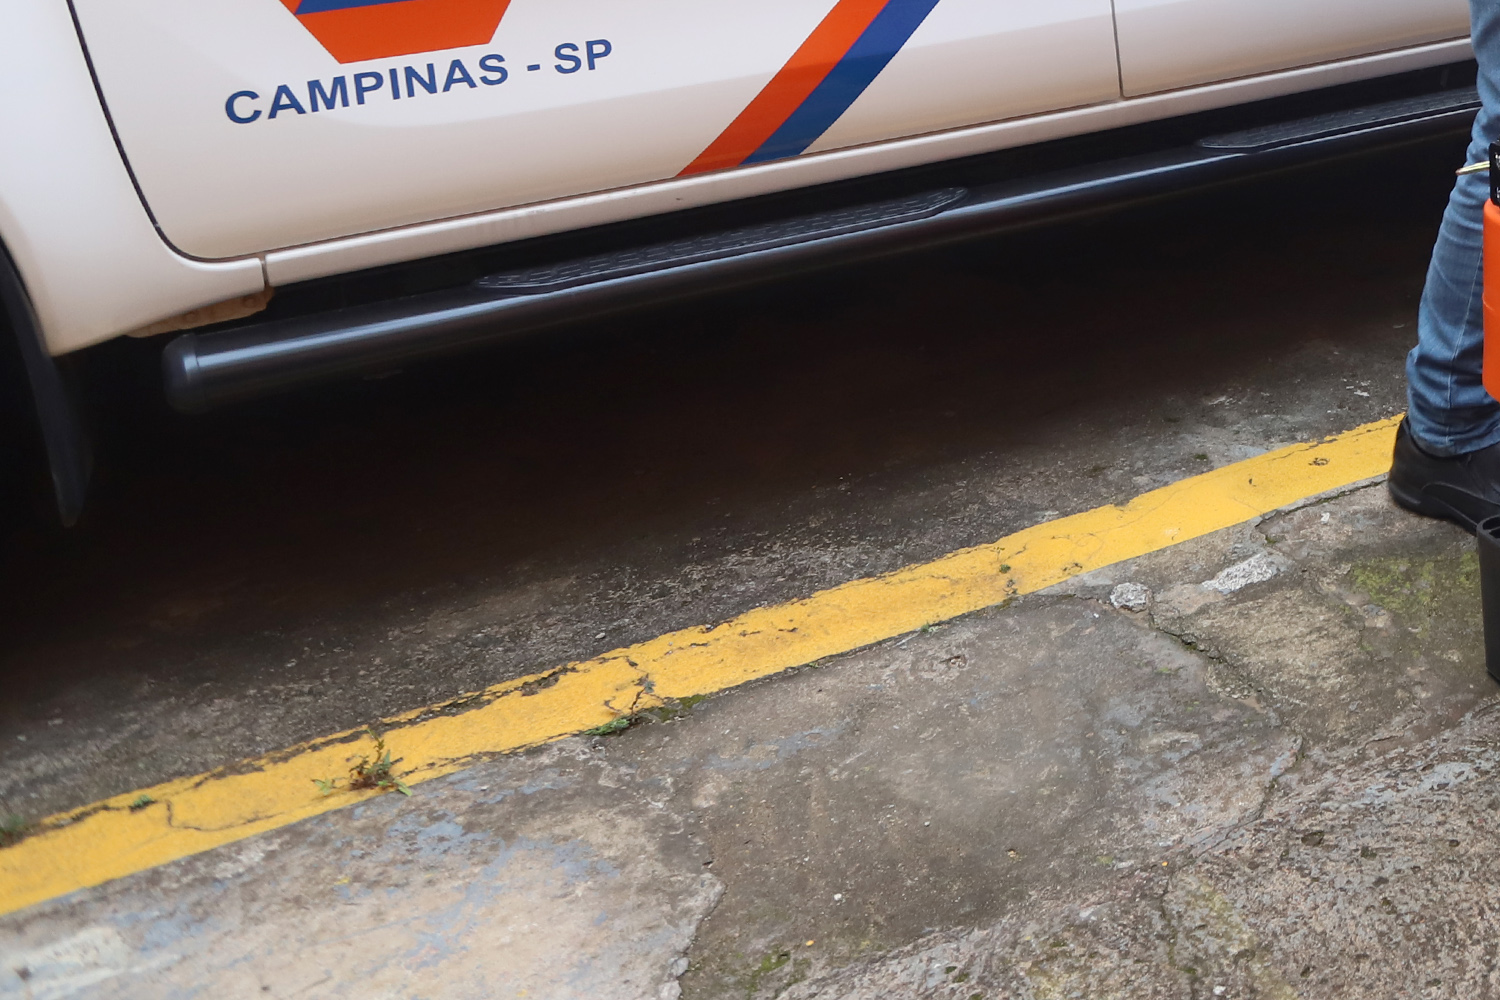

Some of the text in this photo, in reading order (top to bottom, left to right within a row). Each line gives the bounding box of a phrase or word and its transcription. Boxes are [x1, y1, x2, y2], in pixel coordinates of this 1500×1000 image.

[225, 38, 612, 124] CAMPINAS - SP
